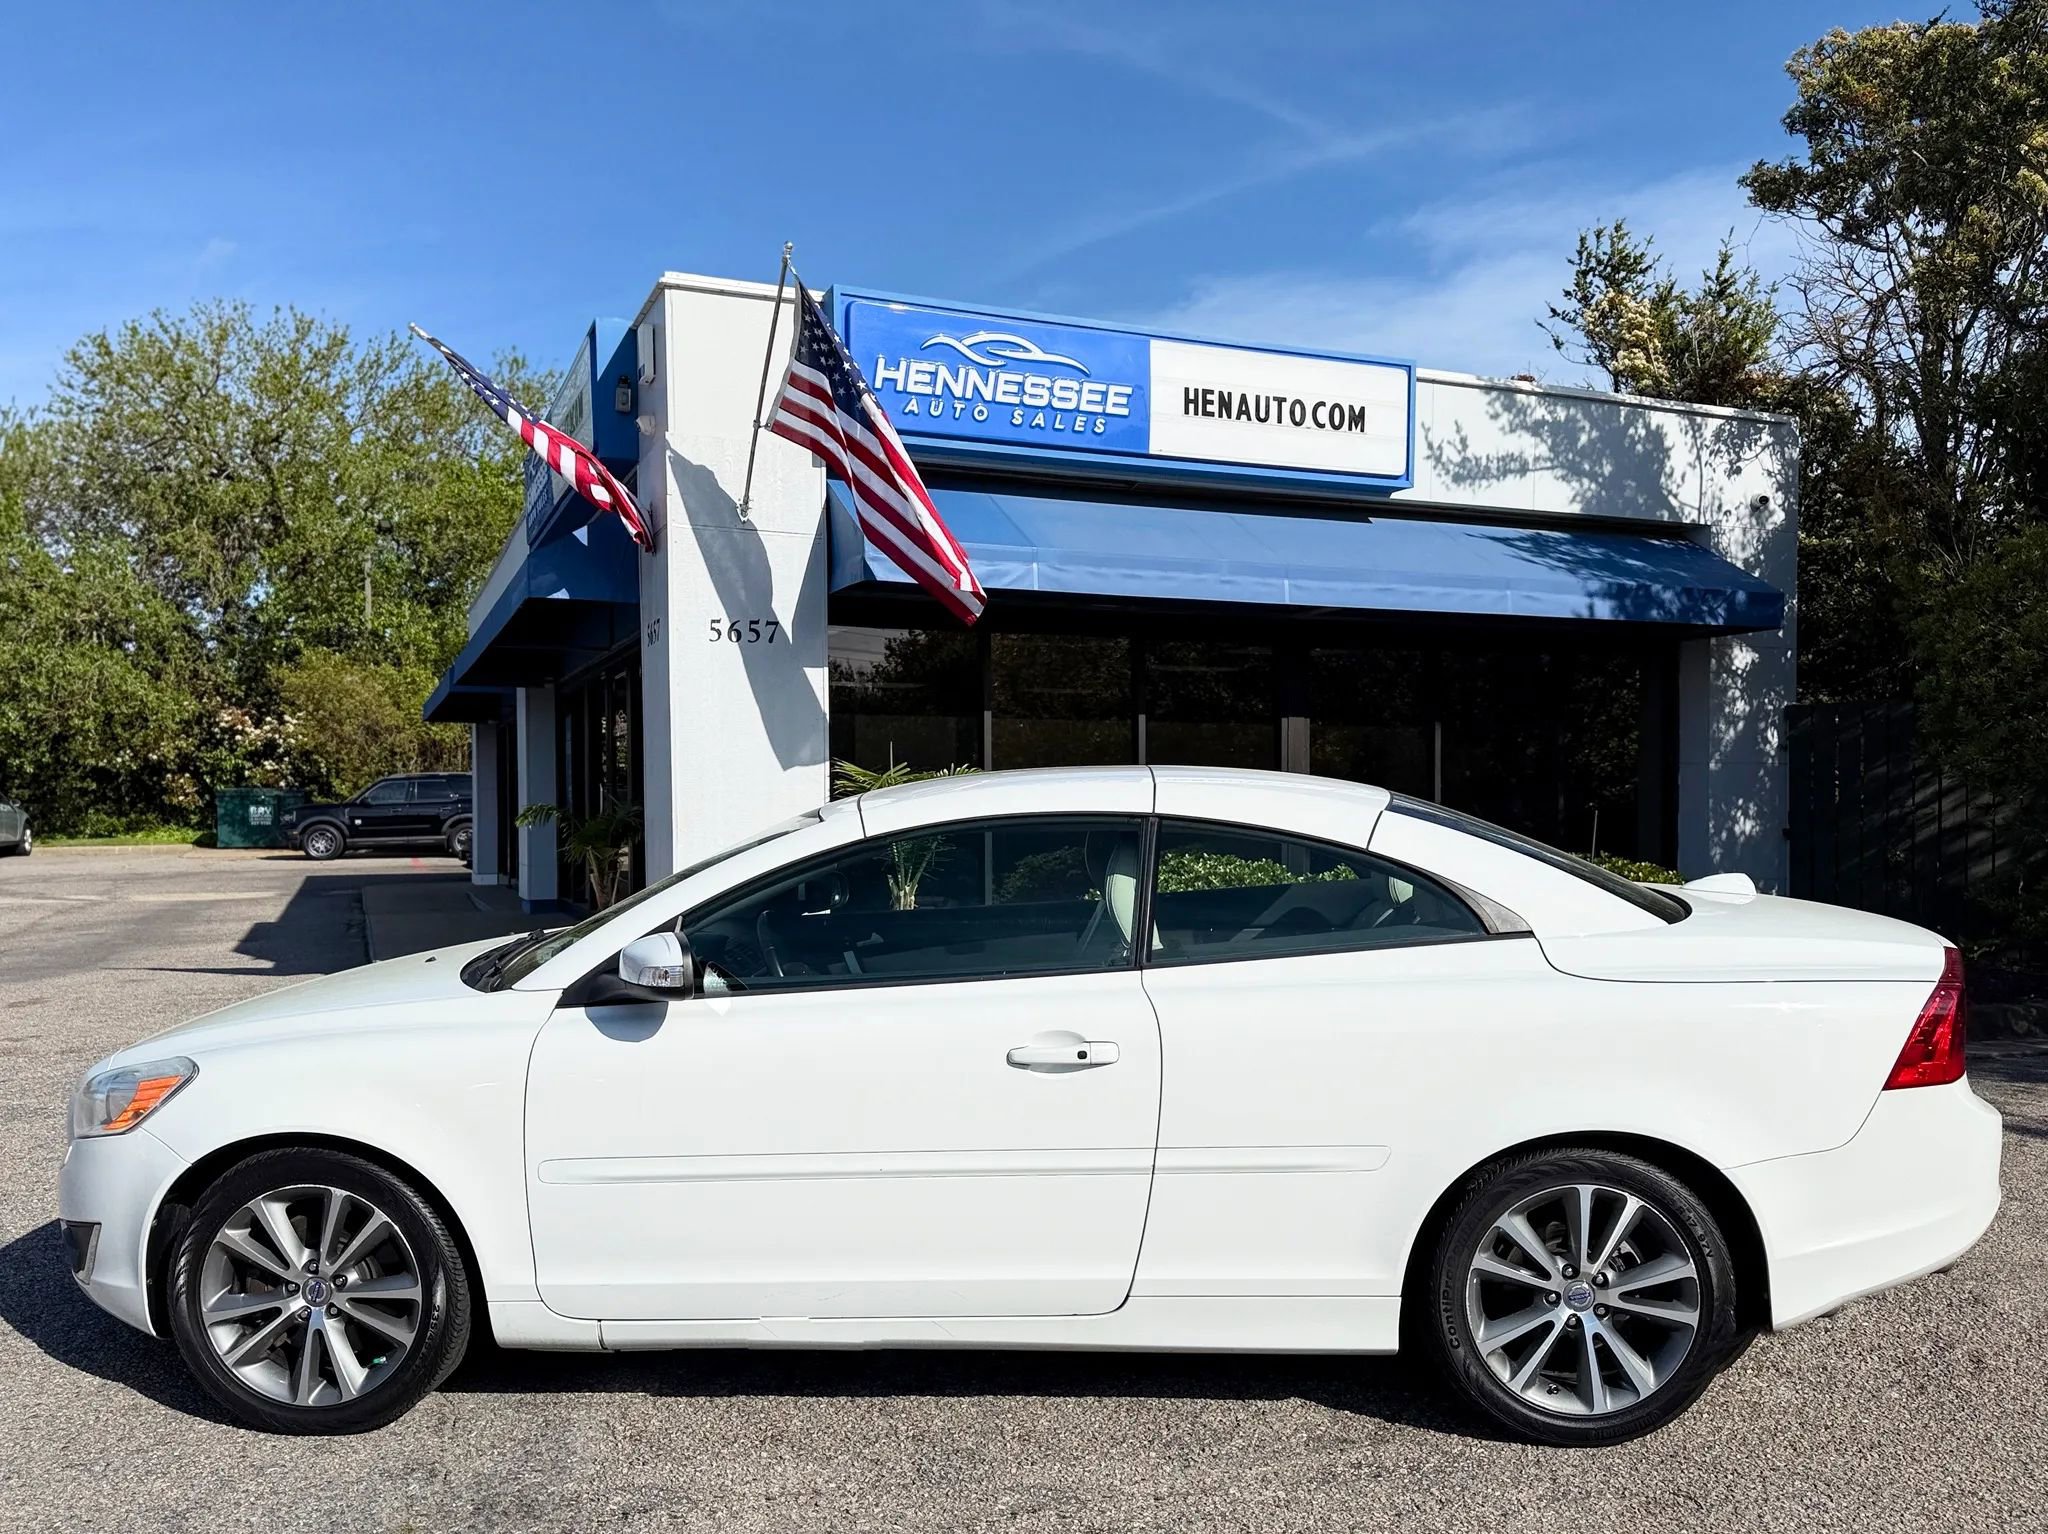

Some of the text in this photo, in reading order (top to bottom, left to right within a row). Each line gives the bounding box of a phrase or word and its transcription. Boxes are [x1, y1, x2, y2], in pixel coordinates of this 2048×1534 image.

[873, 355, 1133, 416] HENNESSEE
[904, 397, 1106, 434] AUTO SALES
[708, 617, 780, 644] 5657
